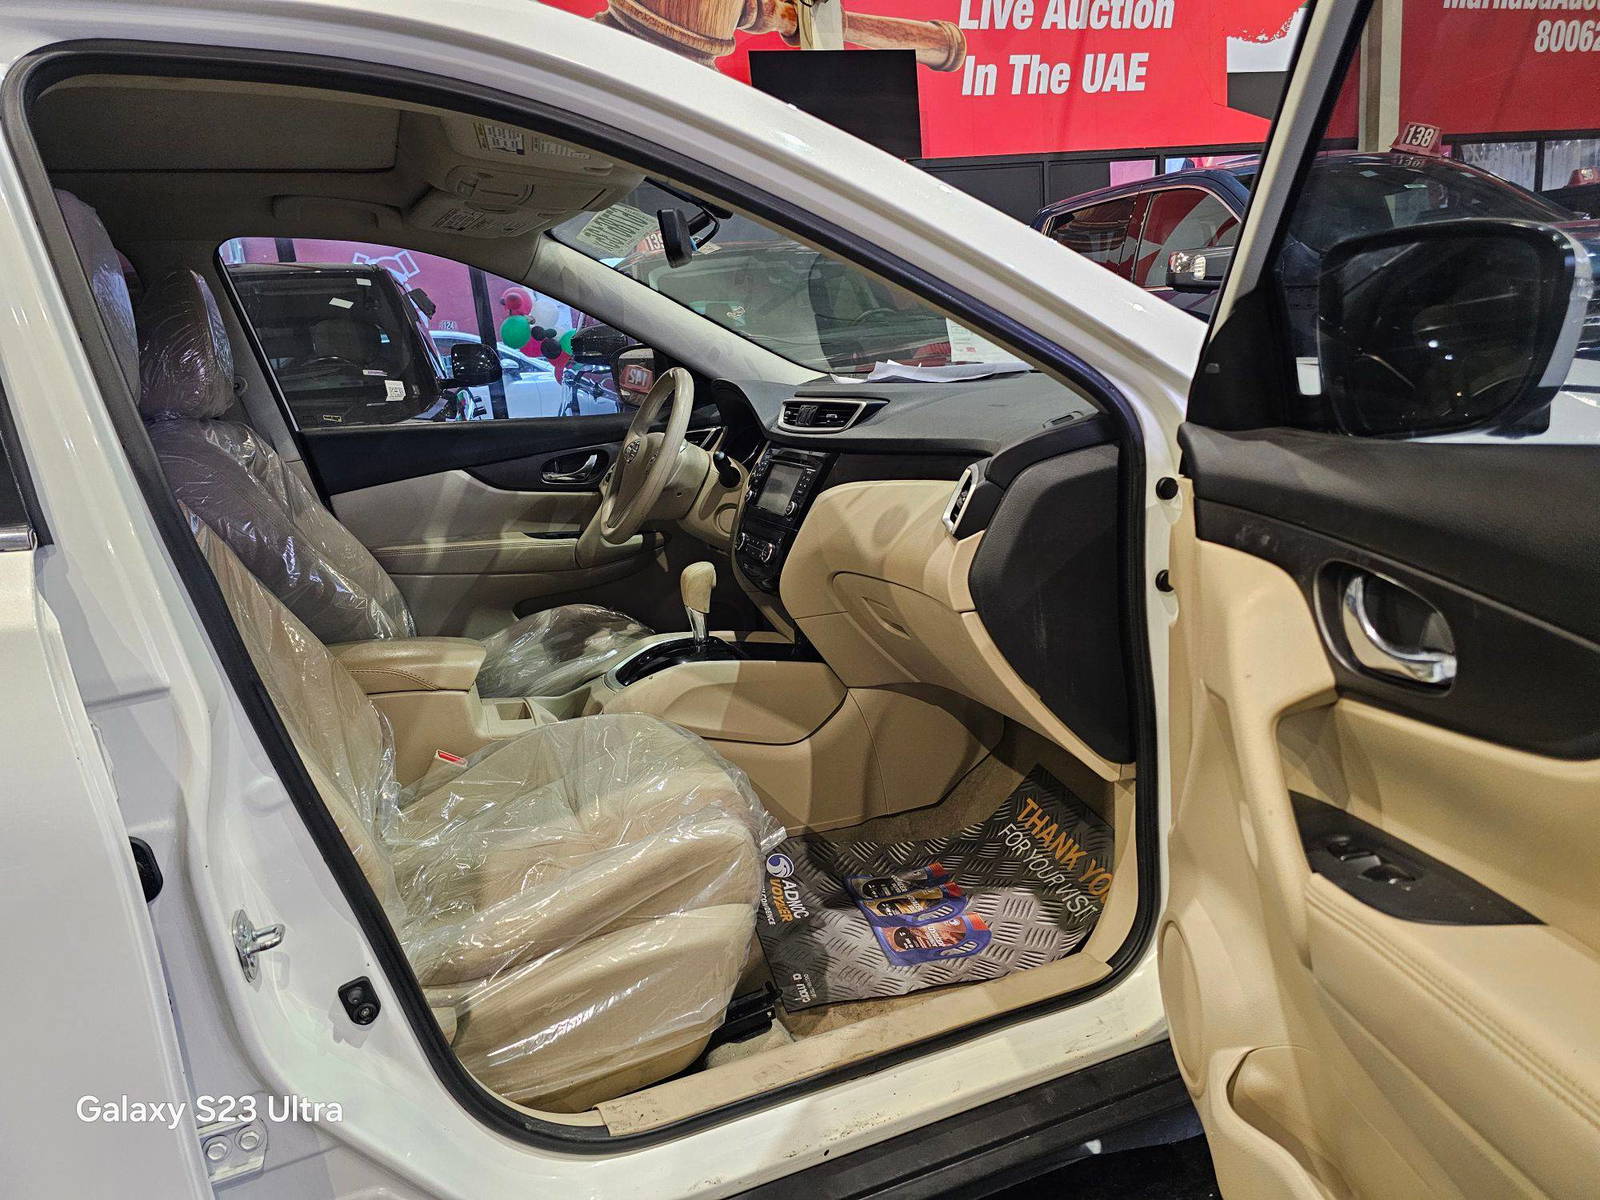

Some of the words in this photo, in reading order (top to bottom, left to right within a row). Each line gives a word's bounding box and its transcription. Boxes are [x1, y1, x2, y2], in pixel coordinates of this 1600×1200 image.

[958, 0, 1034, 30] Live
[1042, 0, 1175, 30] Auction
[962, 56, 998, 96] In
[1009, 55, 1070, 95] The
[1082, 53, 1150, 93] UAE
[1405, 125, 1435, 147] 138
[1017, 797, 1088, 870] THANK
[1078, 858, 1113, 904] YO
[998, 823, 1031, 856] FOR
[1023, 848, 1065, 887] YOUR
[1055, 882, 1098, 922] VISIT
[782, 880, 810, 919] ADNOC
